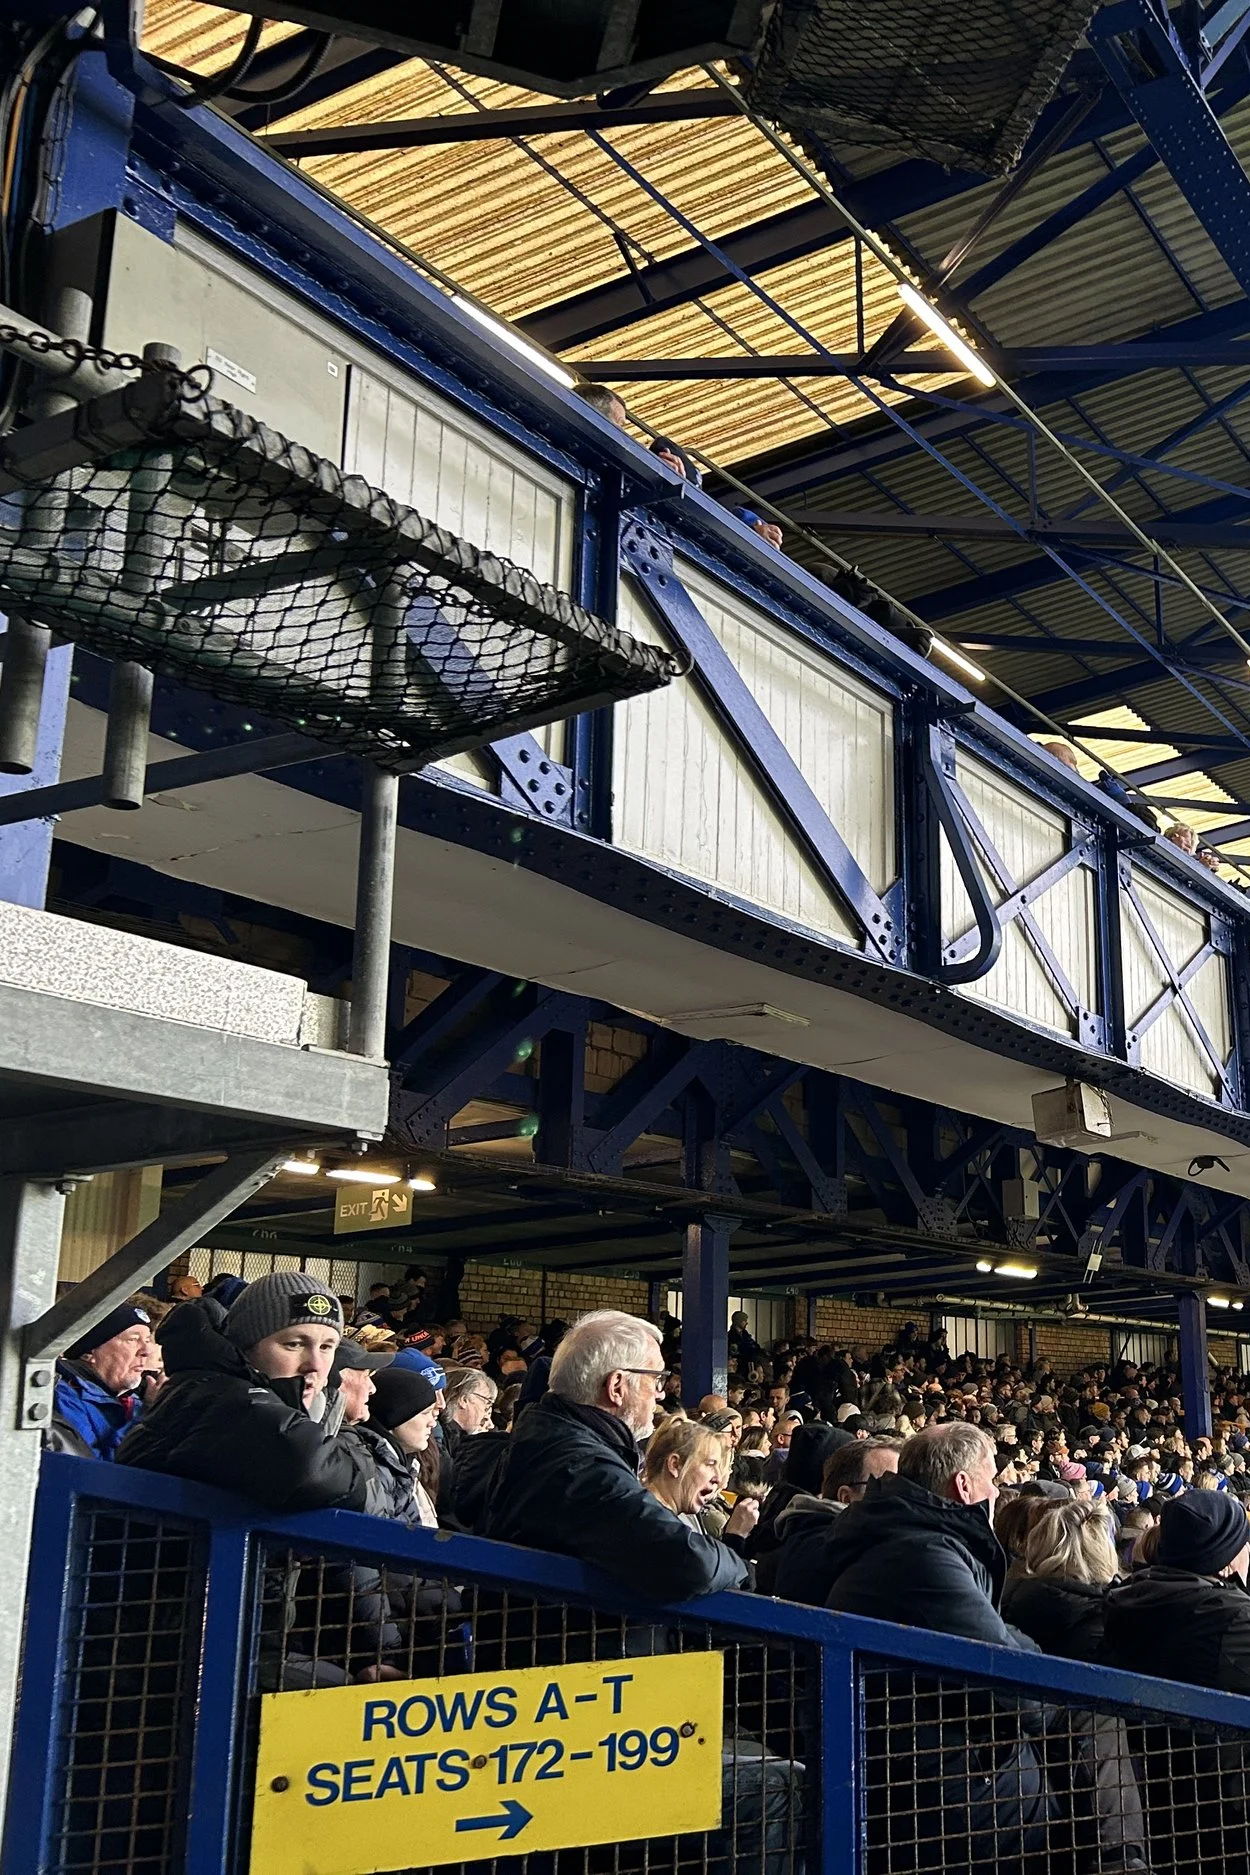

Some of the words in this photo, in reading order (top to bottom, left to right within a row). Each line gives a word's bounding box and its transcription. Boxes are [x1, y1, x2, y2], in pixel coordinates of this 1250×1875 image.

[340, 1202, 368, 1217] EXIT
[363, 1686, 517, 1741] ROWS
[535, 1674, 633, 1723] A-T
[305, 1749, 470, 1806] SEATS
[488, 1726, 681, 1784] 172-199
